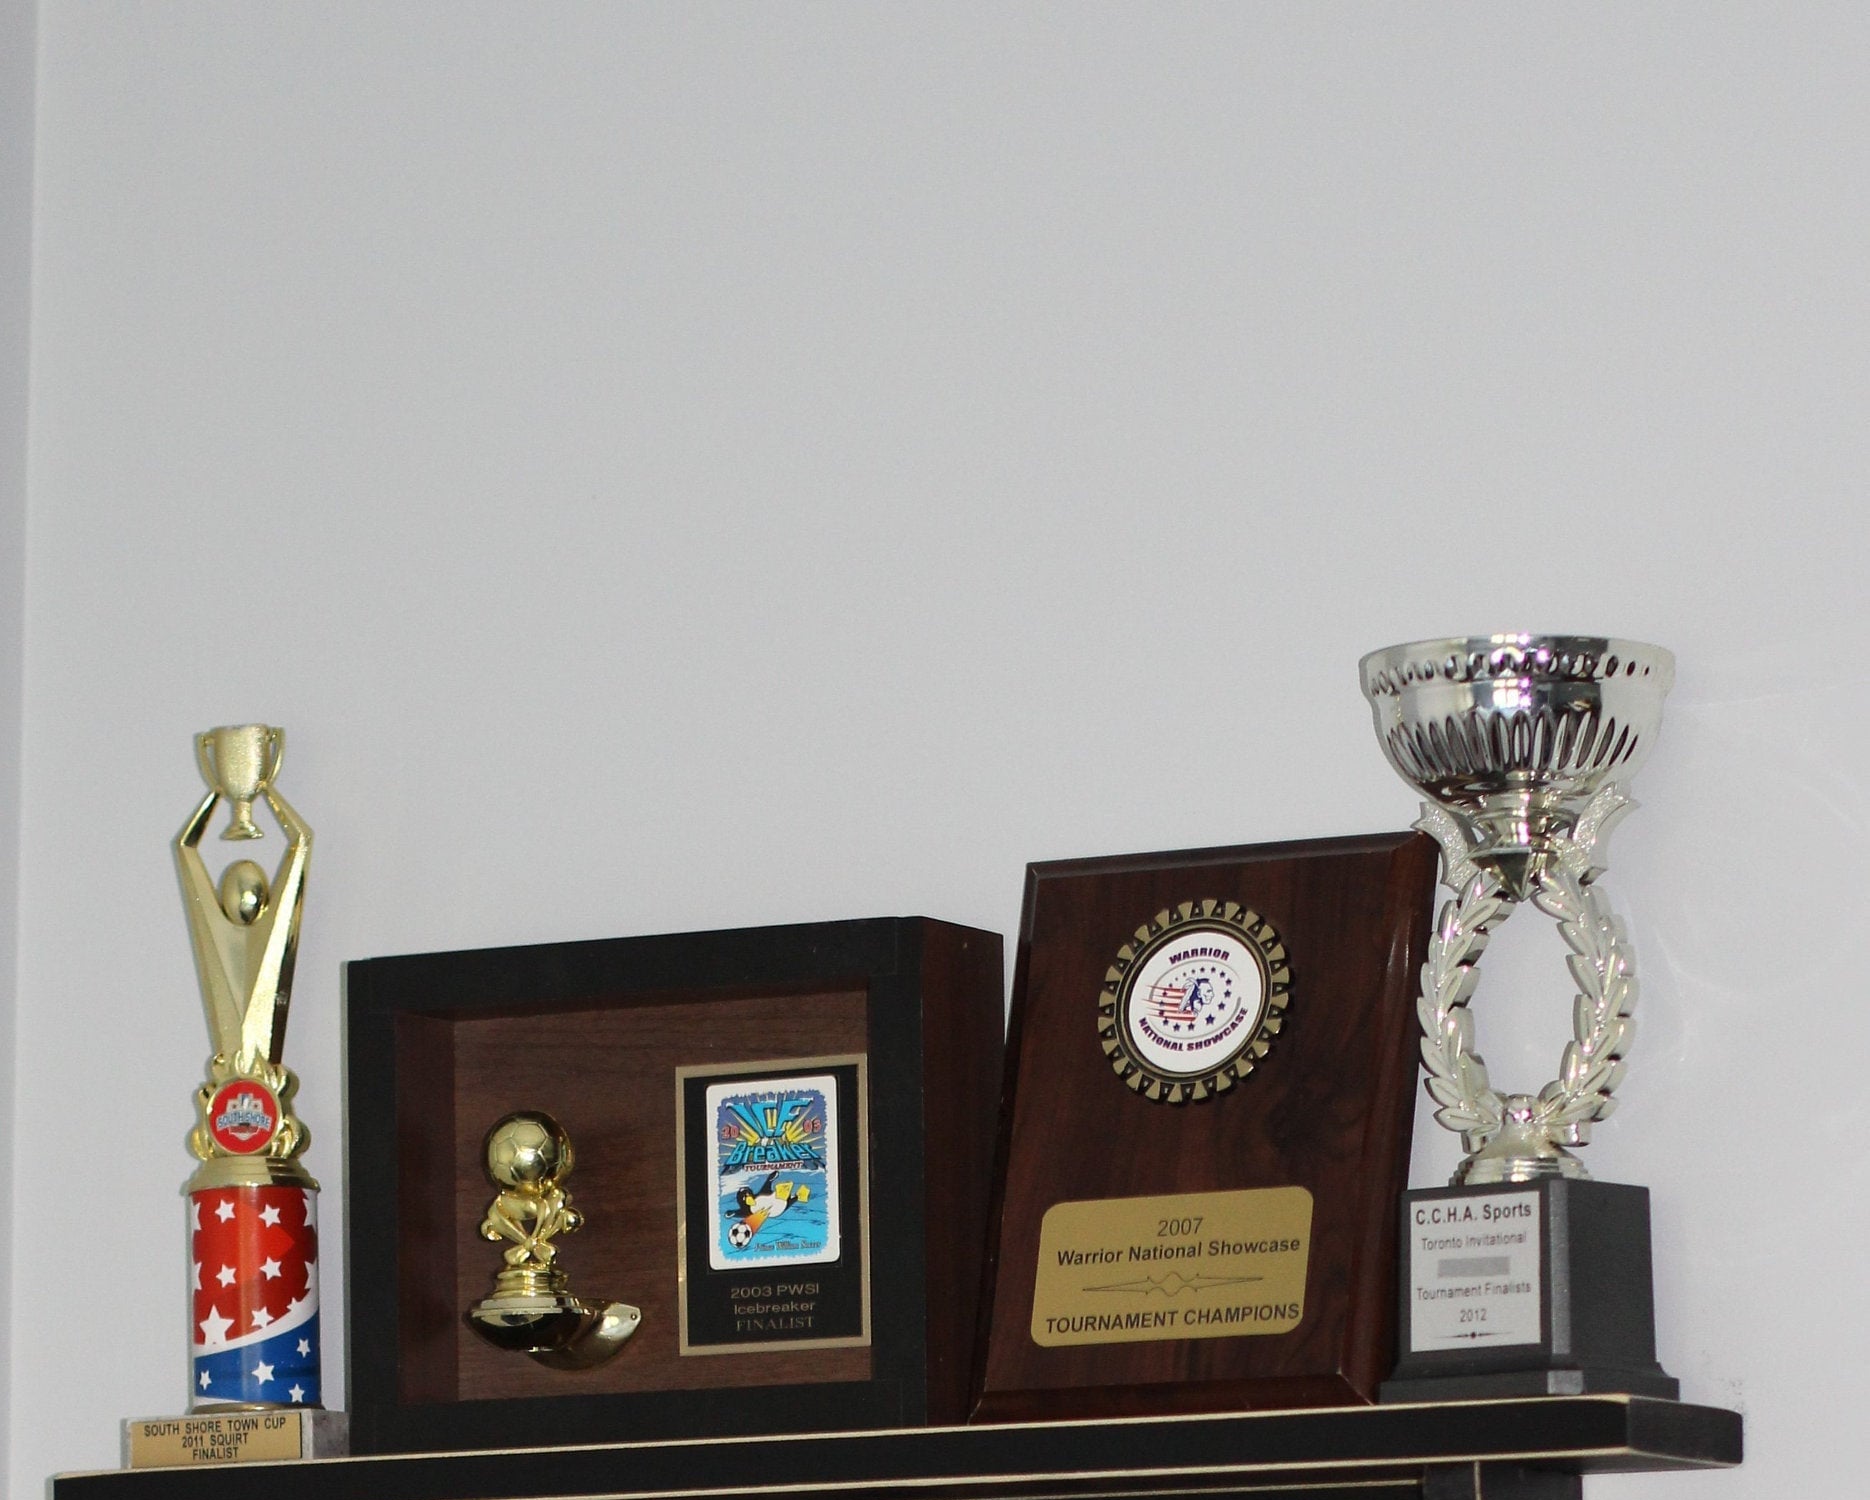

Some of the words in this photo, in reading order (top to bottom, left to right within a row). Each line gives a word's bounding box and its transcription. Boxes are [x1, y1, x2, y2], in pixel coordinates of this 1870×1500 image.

[1169, 947, 1230, 965] WARRIOR
[1139, 1017, 1184, 1052] NATIONAL
[1187, 1007, 1249, 1052] SHOWCASE
[217, 1110, 243, 1128] SOUTH
[244, 1110, 271, 1128] SHORE
[726, 1097, 814, 1137] ICE
[724, 1140, 823, 1167] Breaker
[744, 1161, 804, 1172] TOURNAMENT
[1416, 1206, 1478, 1225] C.C.H.A.
[1483, 1202, 1532, 1223] Sports
[1157, 1217, 1203, 1237] 2007
[1421, 1237, 1462, 1251] Toronto
[1466, 1231, 1527, 1248] Invitational
[1057, 1250, 1124, 1266] Warrior
[1128, 1242, 1202, 1263] National
[1208, 1238, 1301, 1257] Showcase
[730, 1285, 772, 1299] 2003
[777, 1282, 820, 1296] PWSI
[1417, 1285, 1482, 1301] Tournament
[1485, 1282, 1532, 1296] Finalists
[734, 1300, 816, 1316] Icebreaker
[1459, 1308, 1487, 1323] 2012
[736, 1316, 814, 1333] FINALIST
[1046, 1311, 1178, 1334] TOURNAMENT
[1184, 1303, 1300, 1325] CHAMPIONS
[144, 1425, 180, 1437] SOUTH
[185, 1421, 222, 1435] SHORE
[228, 1418, 259, 1432] TOWN
[264, 1416, 286, 1429] CUP
[182, 1436, 204, 1448] 2011
[210, 1432, 249, 1446] SQUIRT
[192, 1447, 239, 1461] FINALIST
